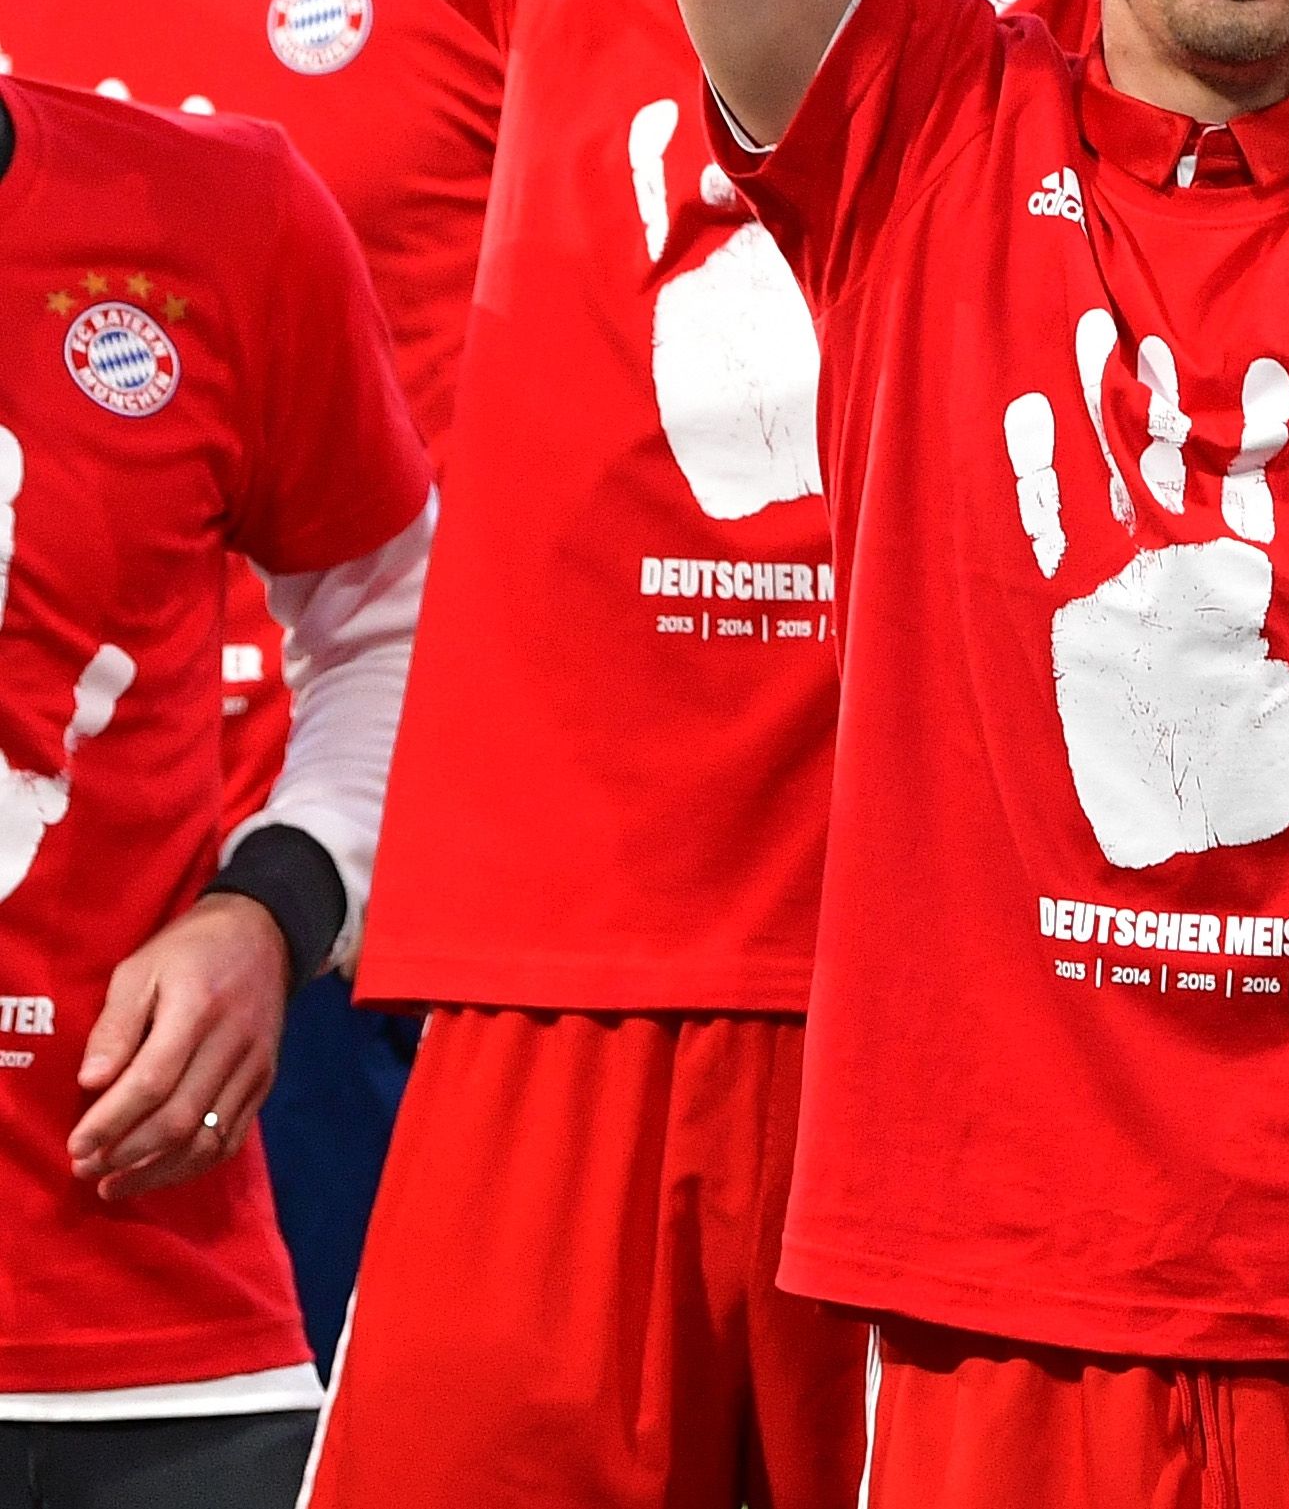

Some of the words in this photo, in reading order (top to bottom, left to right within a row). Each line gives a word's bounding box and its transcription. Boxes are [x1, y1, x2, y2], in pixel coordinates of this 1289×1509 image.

[640, 556, 815, 602] DEUTSCHER
[656, 615, 694, 634] 2013
[716, 618, 753, 637] 2014
[776, 620, 812, 638] 2015
[1039, 896, 1221, 954] DEUTSCHER
[1055, 960, 1086, 981] 2013
[1111, 966, 1151, 986] 2014
[1177, 971, 1216, 991] 2015
[1242, 976, 1280, 994] 2016
